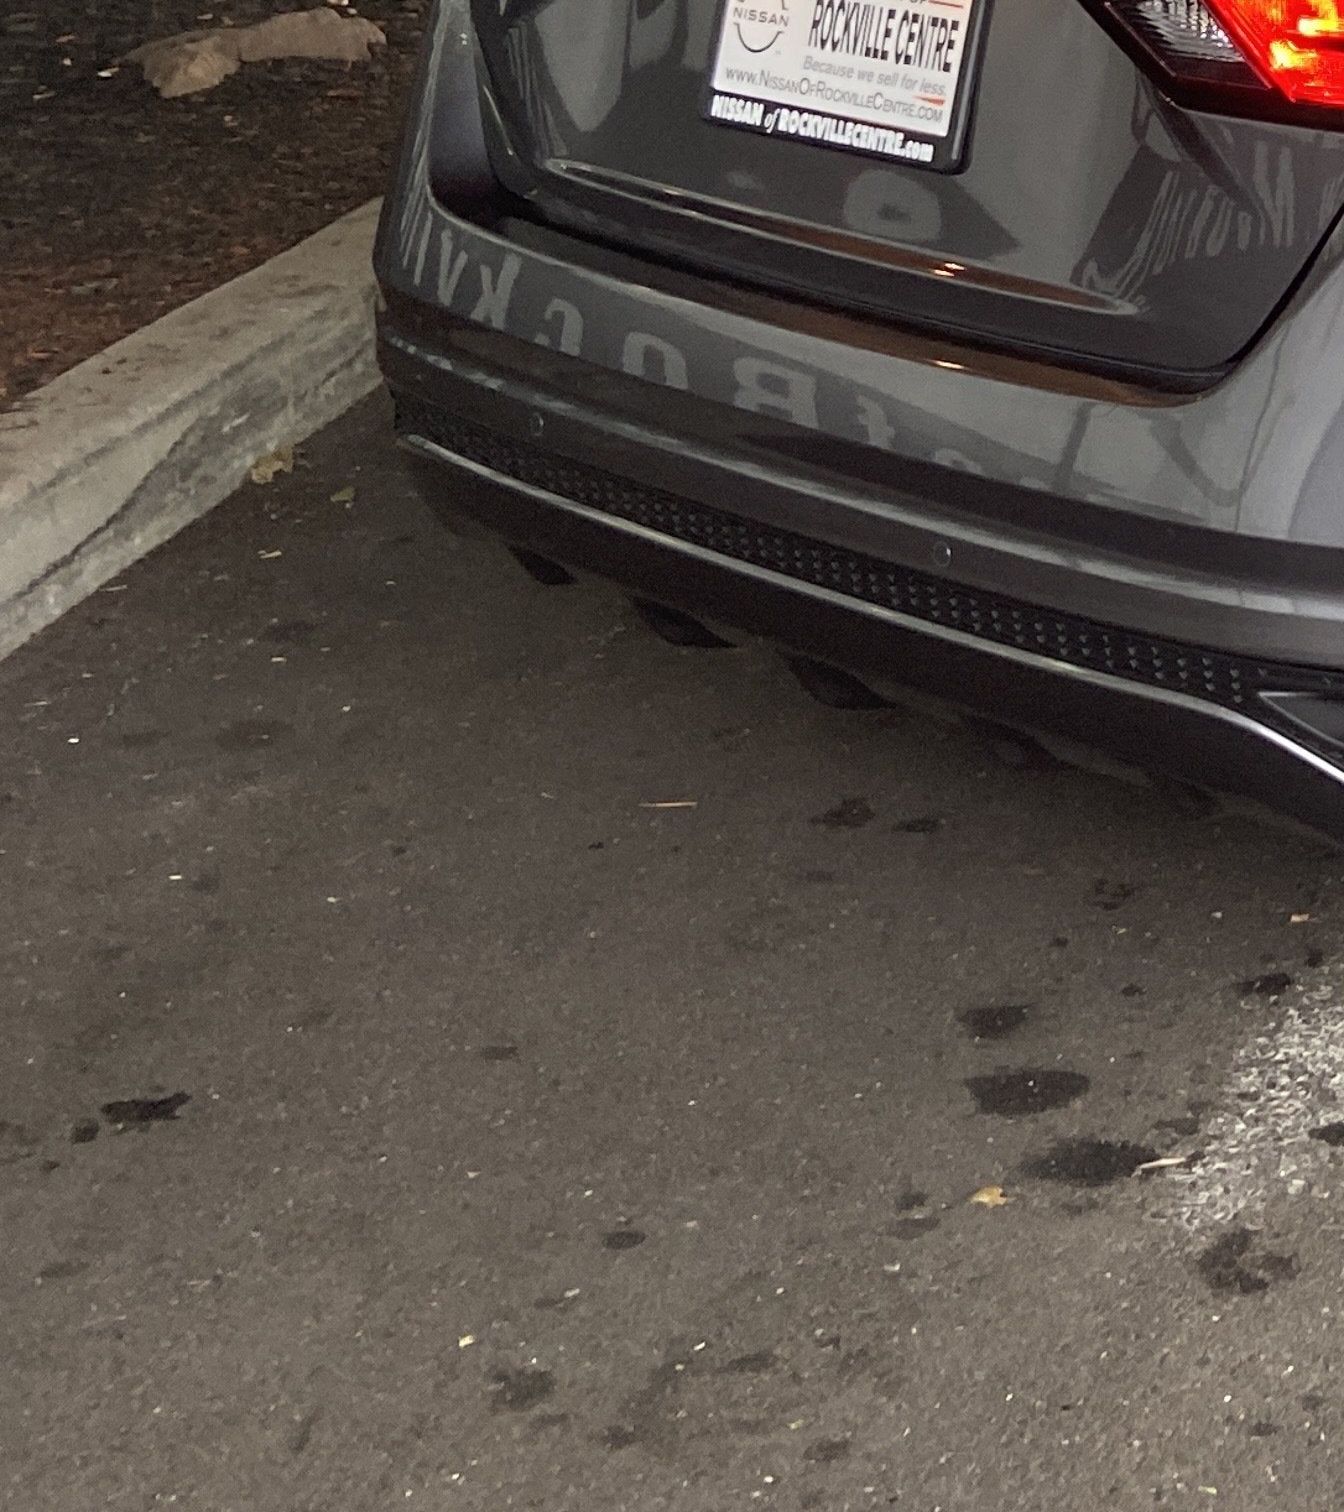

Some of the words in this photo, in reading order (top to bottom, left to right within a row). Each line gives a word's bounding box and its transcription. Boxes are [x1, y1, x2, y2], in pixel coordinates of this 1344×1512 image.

[732, 6, 790, 27] NISSAN
[895, 9, 960, 73] CENTRE
[803, 54, 853, 79] Because
[857, 68, 874, 83] we
[876, 70, 899, 87] sell
[901, 74, 918, 90] for
[710, 94, 764, 126] NISSAN
[764, 108, 780, 134] of
